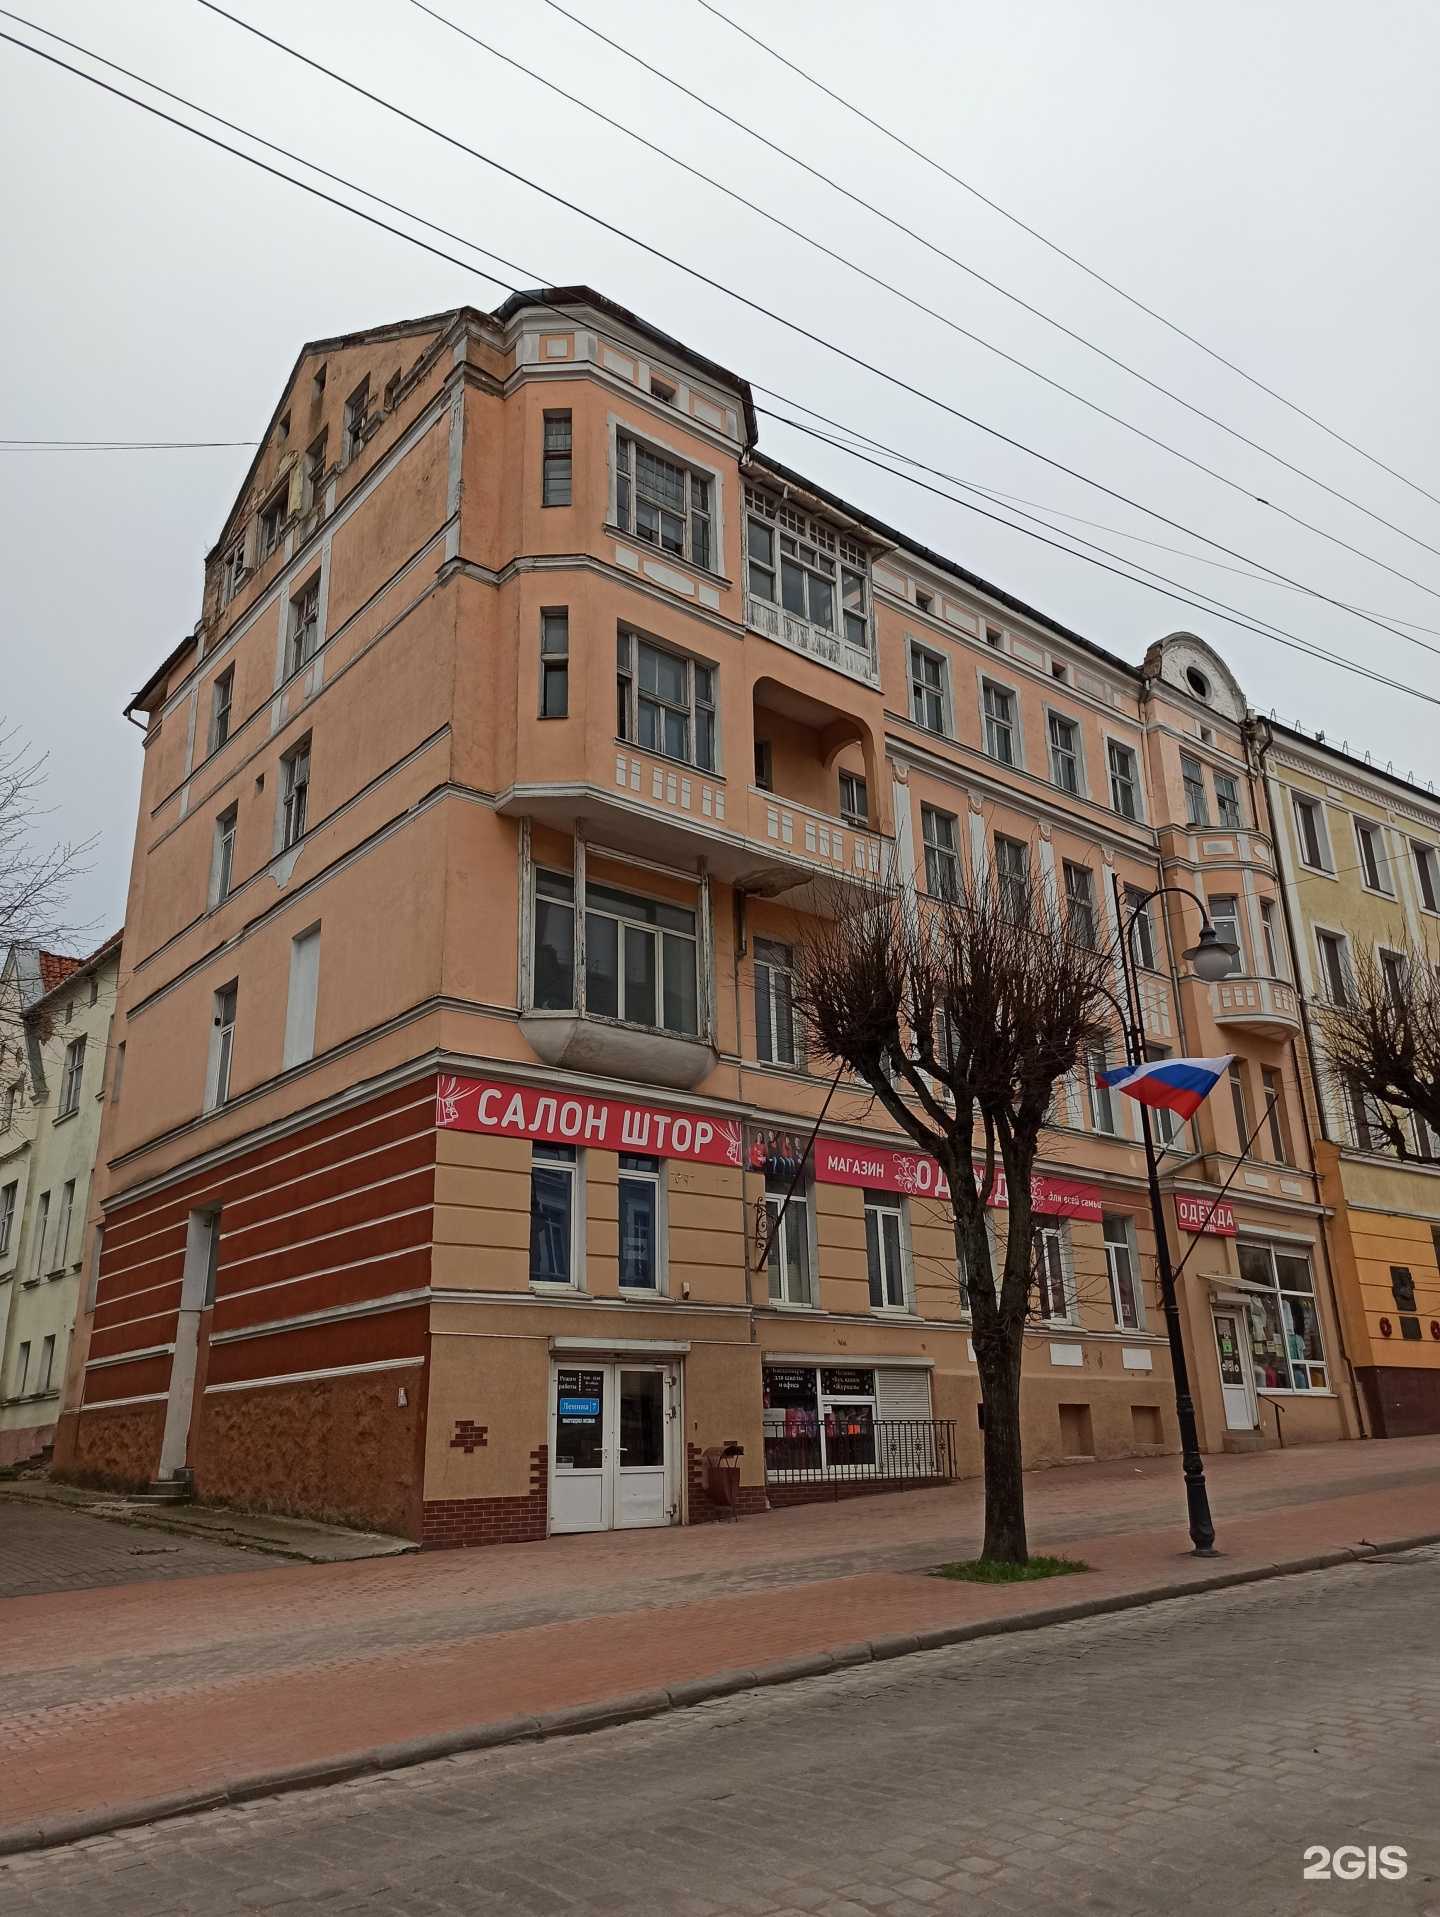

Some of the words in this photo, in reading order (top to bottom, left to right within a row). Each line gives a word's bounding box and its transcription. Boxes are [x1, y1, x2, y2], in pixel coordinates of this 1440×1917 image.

[477, 1088, 608, 1141] САЛОН
[622, 1109, 714, 1154] ШТОР
[827, 1155, 885, 1178] МАГАЗИН
[916, 1160, 1010, 1206] ОДД
[1180, 1203, 1234, 1227] ОДЕЖДА
